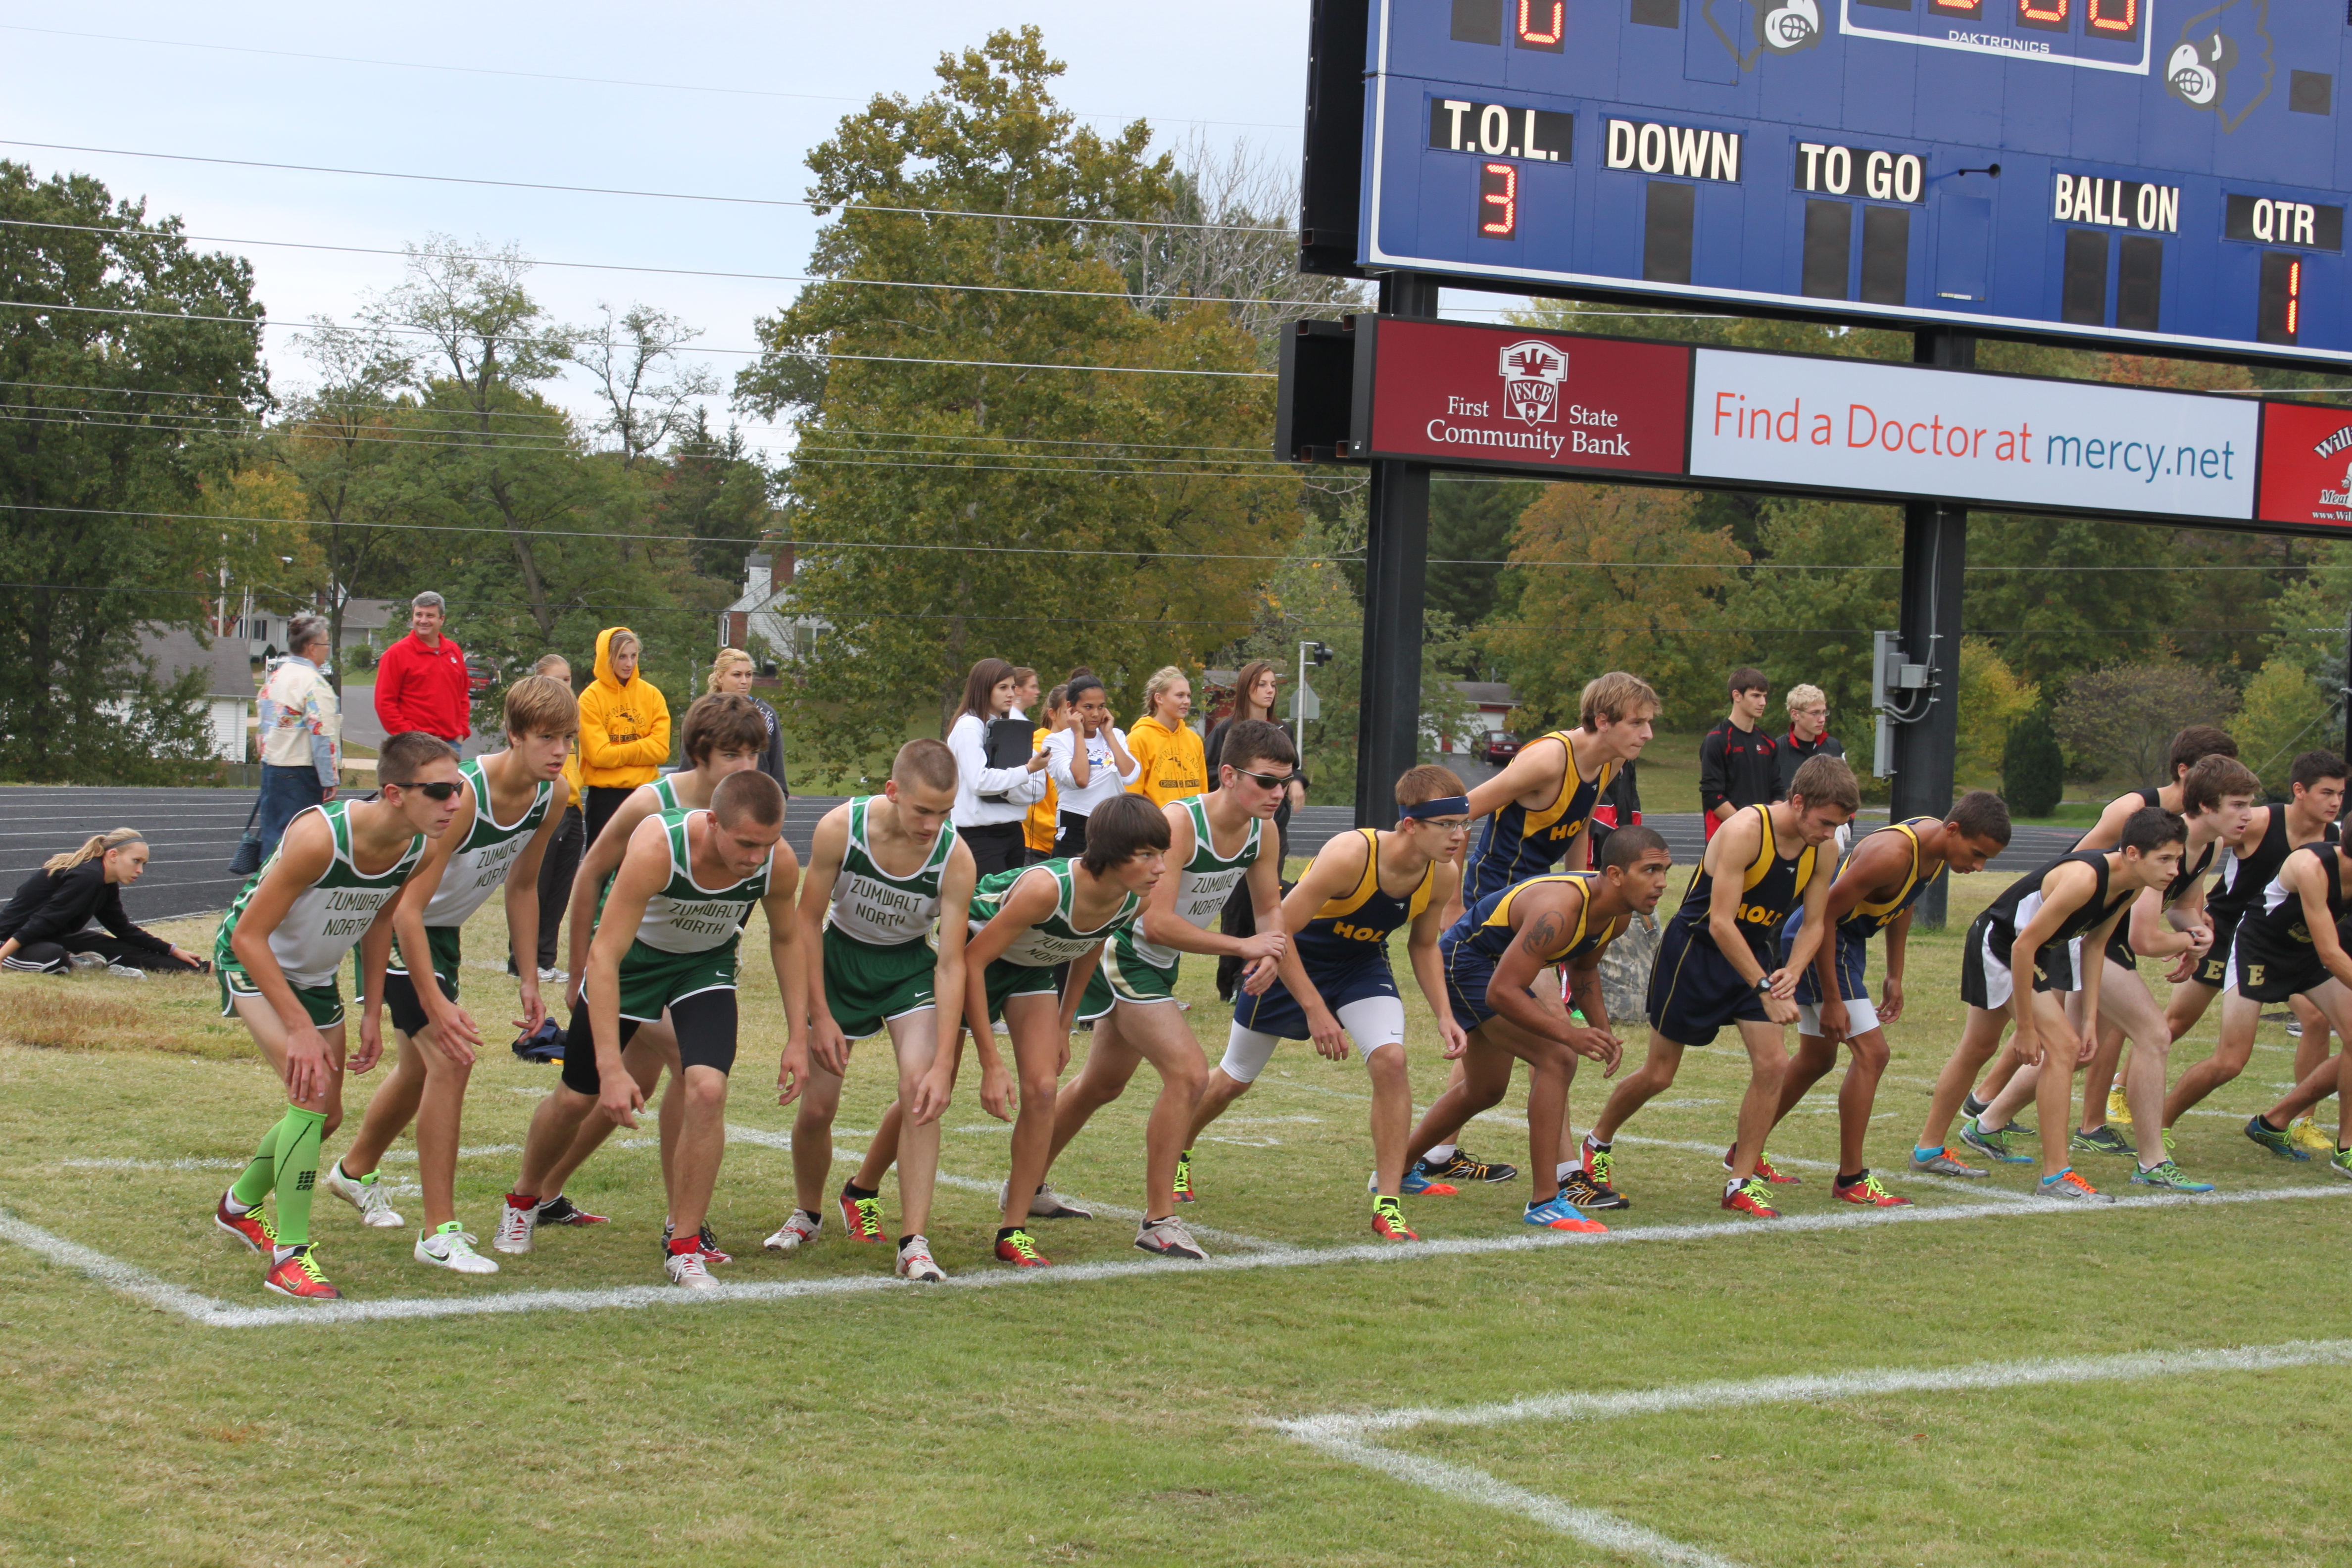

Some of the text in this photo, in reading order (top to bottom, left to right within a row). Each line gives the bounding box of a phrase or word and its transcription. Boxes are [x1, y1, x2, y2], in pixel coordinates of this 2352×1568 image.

[1949, 30, 2050, 53] DAKTRONICS
[1444, 100, 1559, 161] T.O.L.
[1608, 119, 1739, 182] DOWN
[1800, 143, 1921, 202] TO GO
[1484, 164, 1516, 234] 3
[2055, 174, 2179, 233] BALL ON
[2252, 198, 2315, 244] QTR
[2287, 262, 2300, 334] 1
[1512, 382, 1553, 402] FSCB
[1447, 396, 1618, 428] First State
[1426, 419, 1630, 458] Community Bank
[1714, 392, 2234, 484] Find a Doctor at mercy.net
[2313, 426, 2352, 460] Will
[2319, 490, 2350, 505] Meat
[1549, 820, 1583, 840] HO
[669, 902, 746, 919] ZUMWALT
[850, 879, 923, 913] ZUMWALT
[322, 917, 372, 936] NORTH
[670, 918, 726, 934] NORTH
[855, 902, 906, 927] NORTH
[1033, 936, 1100, 953] ZUMWALT
[2203, 959, 2225, 980] E
[2248, 965, 2266, 986] E
